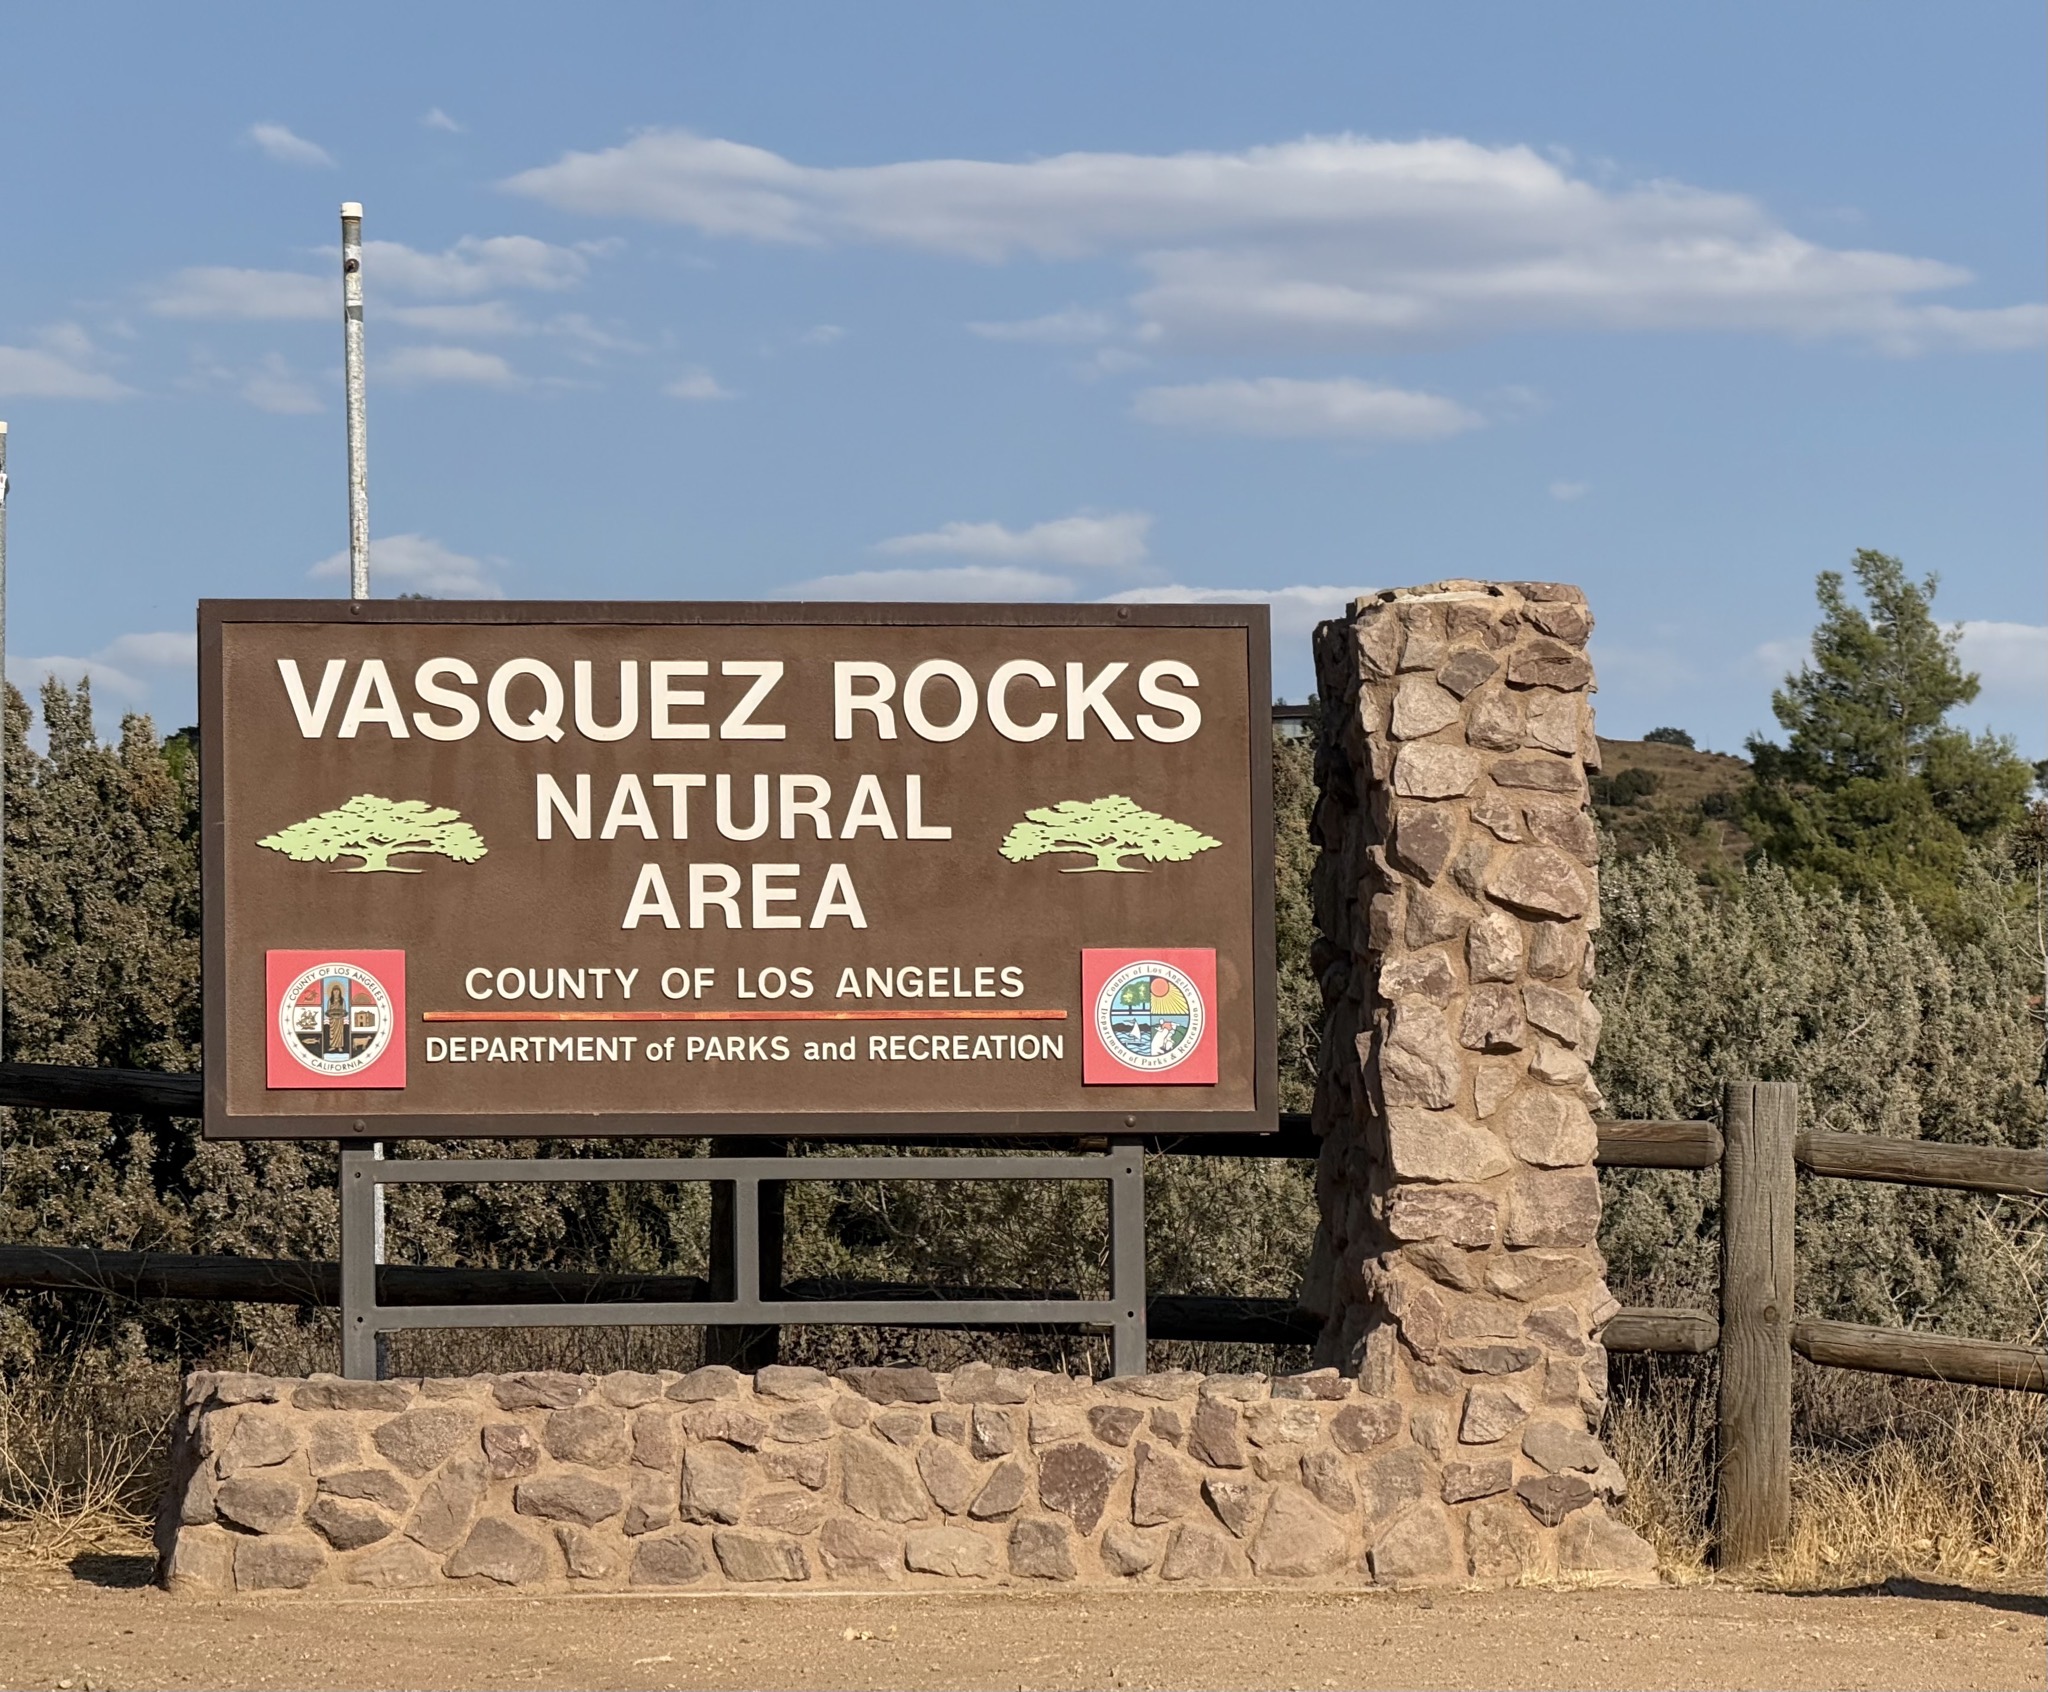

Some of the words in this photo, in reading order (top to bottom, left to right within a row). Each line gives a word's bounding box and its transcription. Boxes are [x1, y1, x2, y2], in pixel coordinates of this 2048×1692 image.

[276, 656, 786, 743] VASQUEZ
[834, 658, 1202, 743] ROCKS
[536, 773, 952, 841] NATURAL
[621, 862, 868, 929] AREA
[289, 972, 317, 1001] COUNTY
[318, 968, 330, 977] OF
[334, 967, 350, 976] LOS
[352, 972, 384, 1002] ANGELES
[465, 967, 639, 1000] COUNTY
[661, 967, 715, 999] OF
[737, 966, 814, 999] LOS
[835, 966, 1025, 998] ANGELES
[1106, 973, 1130, 997] County
[1133, 967, 1142, 975] of
[1147, 965, 1162, 975] Los
[1165, 970, 1193, 998] Angeles
[426, 1036, 638, 1062] DEPARTMENT
[645, 1036, 676, 1062] of
[687, 1035, 790, 1061] PARKS
[803, 1035, 856, 1061] and
[869, 1034, 1064, 1061] RECREATION
[1100, 1007, 1127, 1058] Department
[1129, 1055, 1138, 1063] of
[1141, 1057, 1168, 1067] Parks
[1170, 1053, 1177, 1061] &
[1177, 1006, 1199, 1054] Recreation
[311, 1059, 364, 1072] CALIFORNIA
